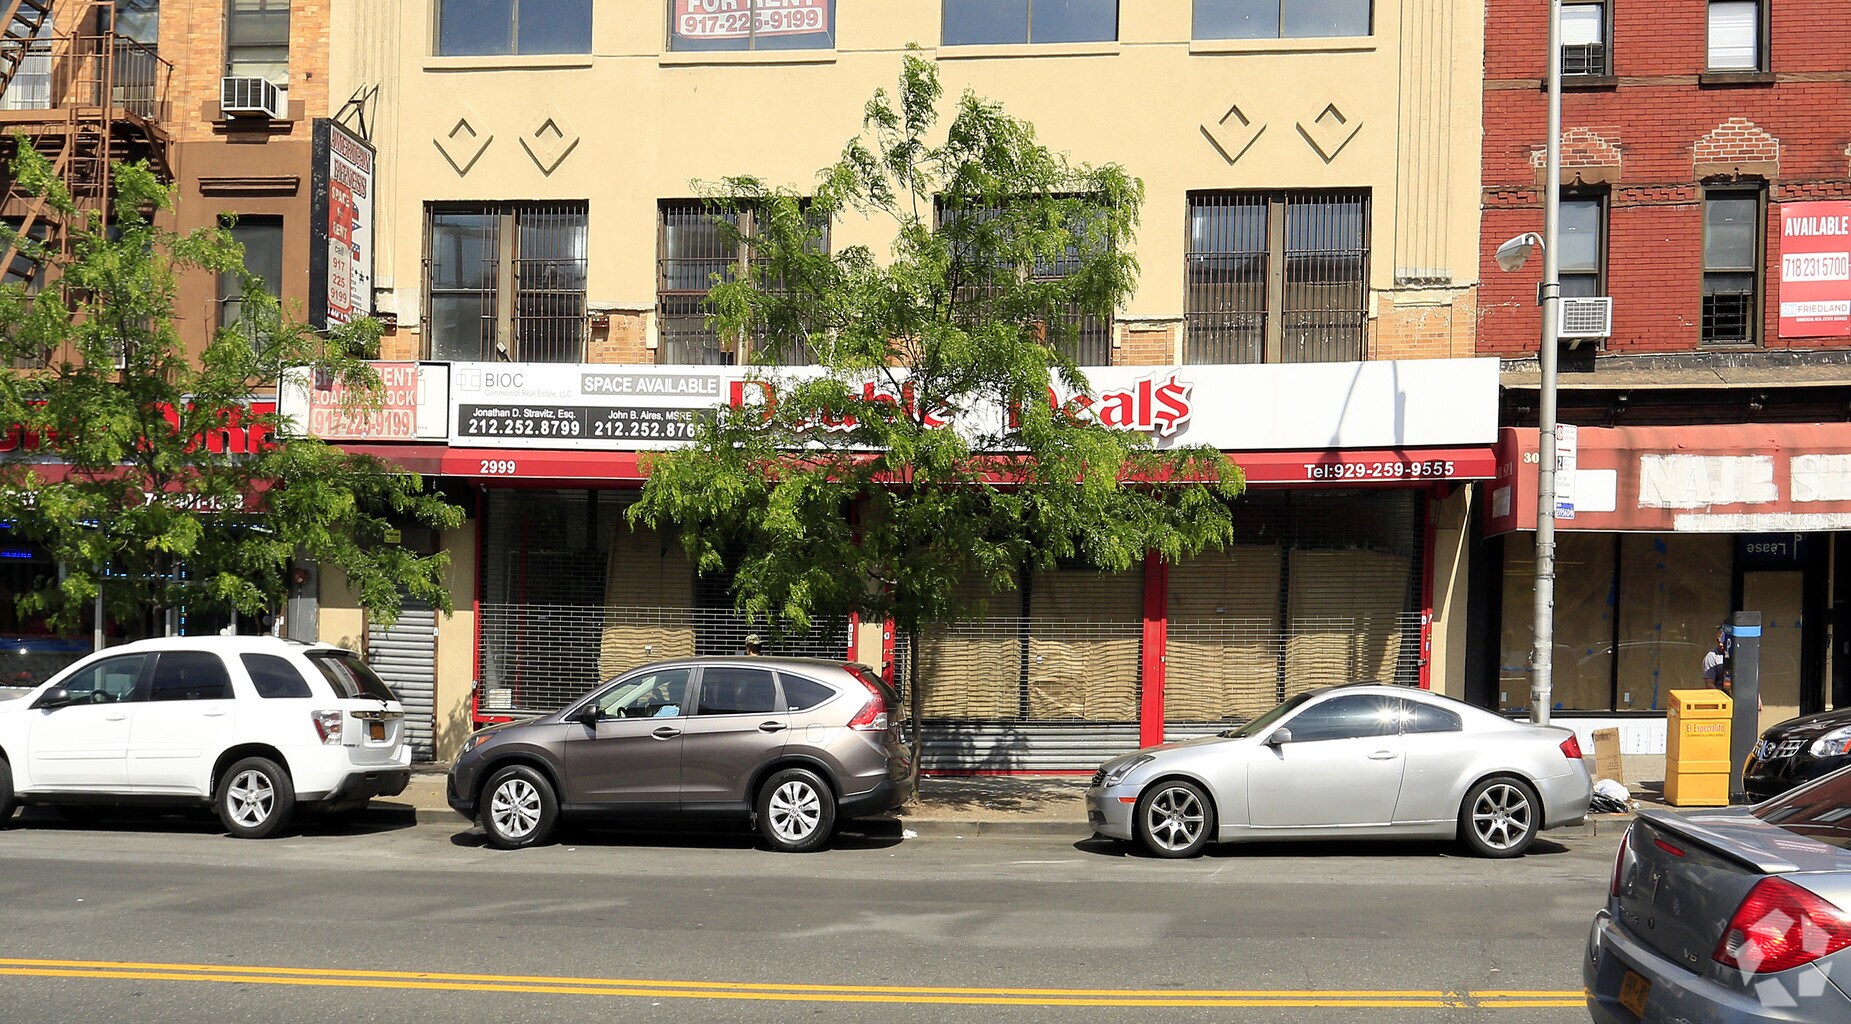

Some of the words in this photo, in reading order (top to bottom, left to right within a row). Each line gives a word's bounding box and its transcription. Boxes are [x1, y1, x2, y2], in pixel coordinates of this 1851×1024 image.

[684, 10, 819, 33] 917-225-9199
[331, 185, 350, 208] SPACE
[332, 220, 348, 240] RENT
[1784, 215, 1849, 236] AVAILABLE
[334, 245, 345, 257] call
[332, 257, 345, 272] 917
[1785, 258, 1802, 276] 718
[1803, 257, 1820, 276] 231
[1822, 256, 1847, 276] 5700
[332, 273, 346, 289] 225
[330, 287, 347, 304] 9199
[1797, 304, 1848, 313] FRIEDLAND
[485, 373, 523, 387] BIOC
[584, 376, 632, 392] SPACE
[635, 377, 717, 394] AVAILABLE
[377, 390, 415, 406] OCK
[484, 389, 520, 397] Commercial
[521, 389, 536, 397] Real
[559, 390, 572, 398] LLC
[473, 407, 510, 418] Jonathan
[512, 408, 521, 418] D.
[523, 408, 556, 419] Stravitz,
[558, 409, 576, 420] Esq.
[608, 410, 629, 420] John
[630, 410, 638, 419] B.
[640, 411, 664, 421] Aires,
[468, 418, 580, 436] 212.252.8799
[480, 459, 516, 475] 2999
[1303, 461, 1455, 479] Tel:929-259-9555
[1747, 543, 1786, 555] Lease
[1686, 723, 1692, 733] El
[1683, 947, 1699, 962] V6
